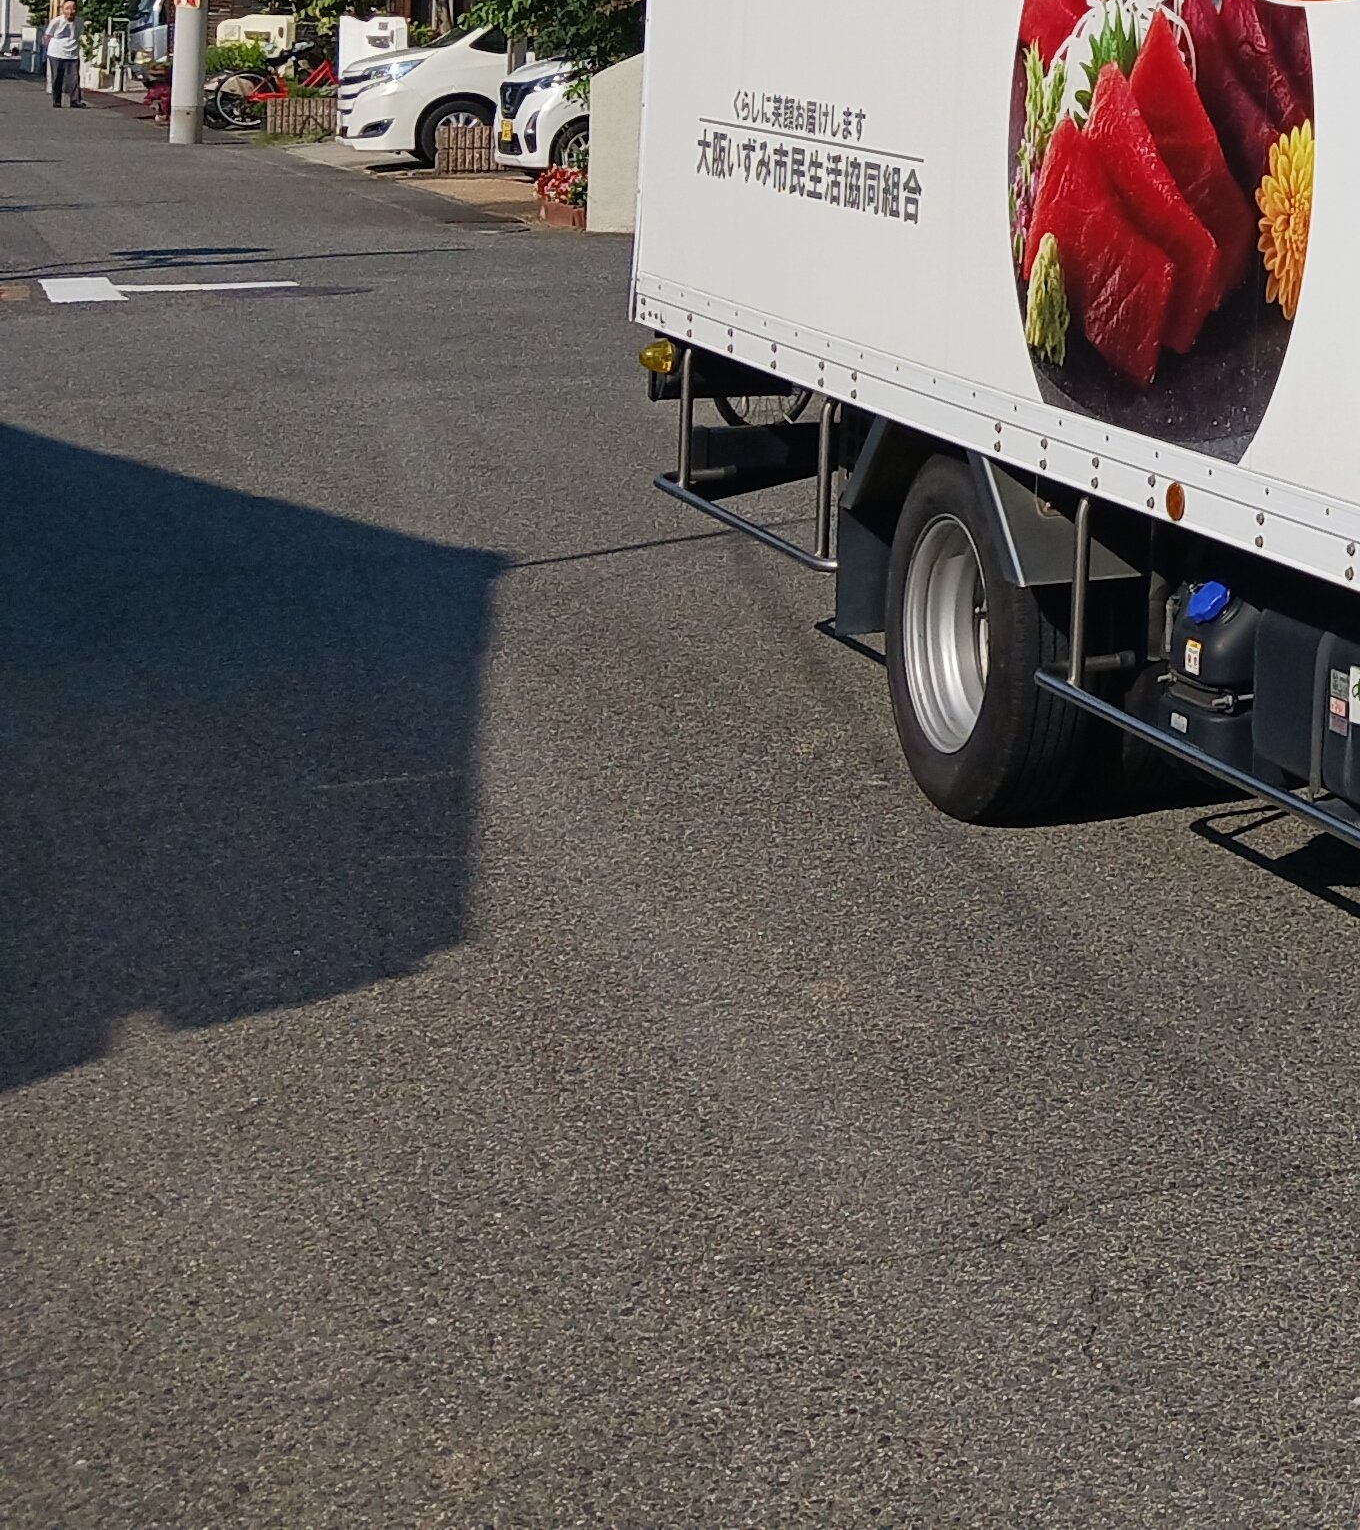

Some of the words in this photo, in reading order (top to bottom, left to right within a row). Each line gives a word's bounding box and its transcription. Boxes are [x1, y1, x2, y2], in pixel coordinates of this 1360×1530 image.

[733, 89, 867, 142] くらしに笑顔お届けします
[697, 128, 923, 225] 大阪いずみ市民生活協同組合
